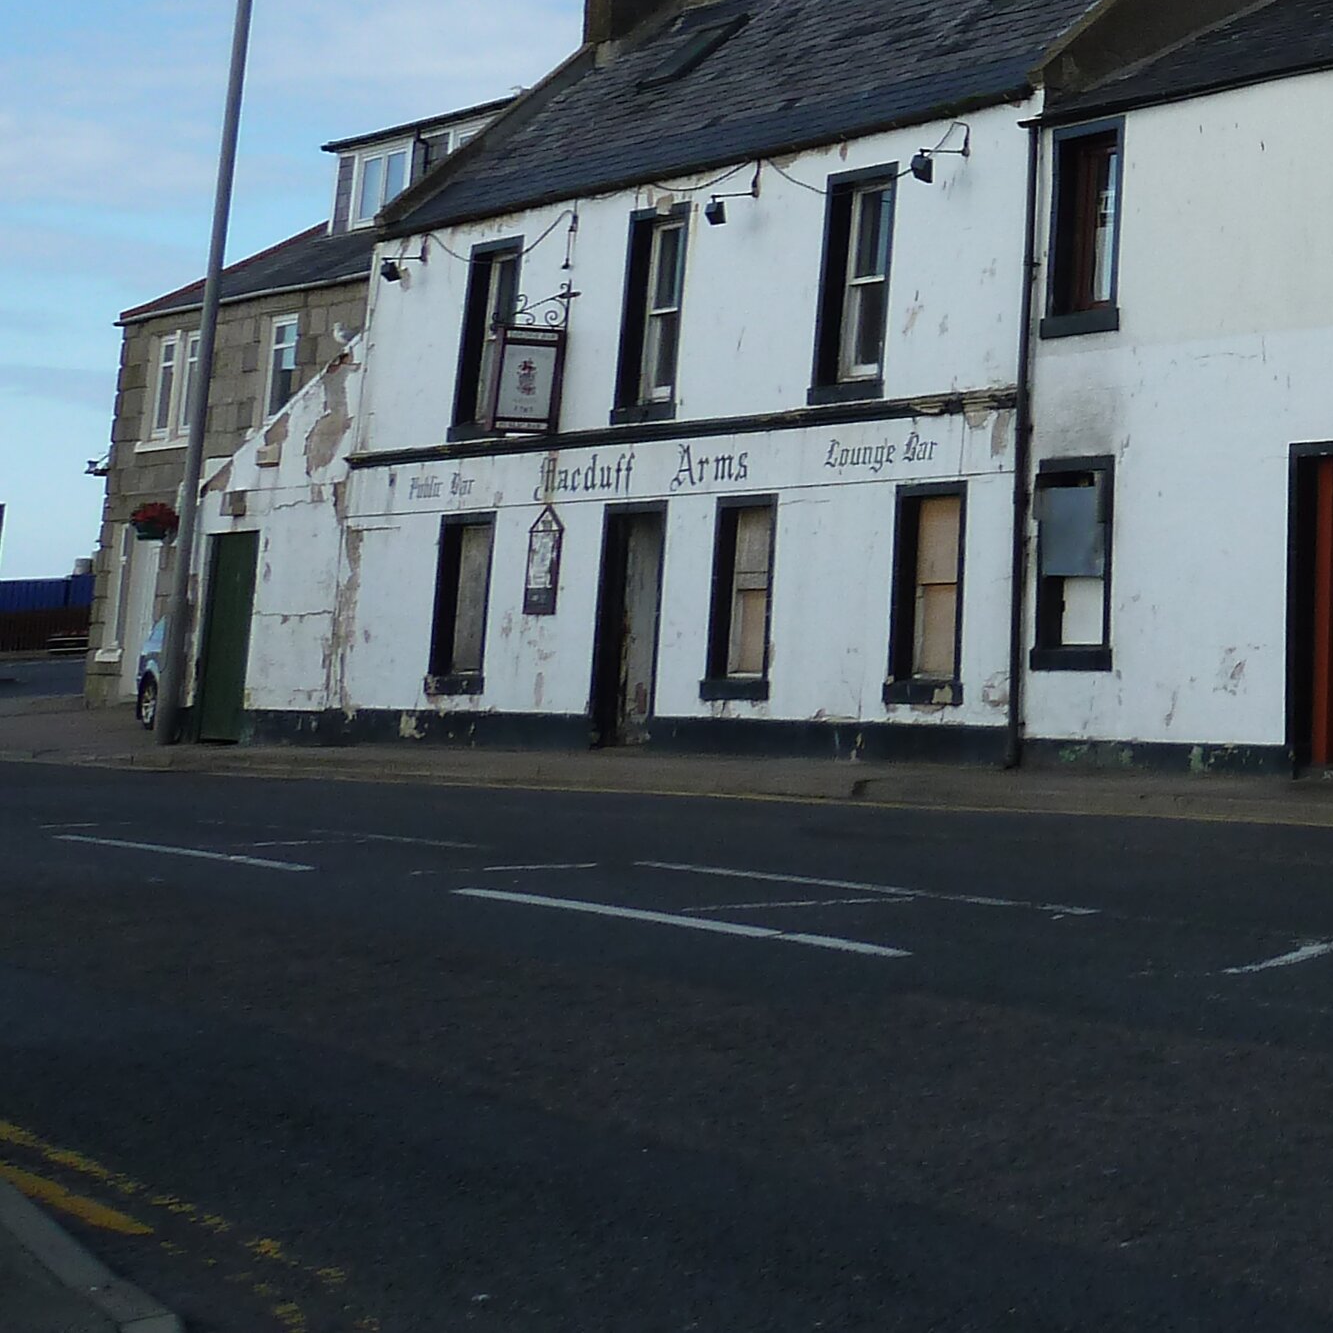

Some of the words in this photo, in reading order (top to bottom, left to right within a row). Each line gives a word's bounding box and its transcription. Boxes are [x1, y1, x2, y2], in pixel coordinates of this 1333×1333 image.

[533, 451, 636, 502] Macduff
[669, 443, 749, 492] Arms
[824, 439, 896, 474] Lounge
[902, 431, 938, 463] Bar
[451, 472, 476, 495] Bar
